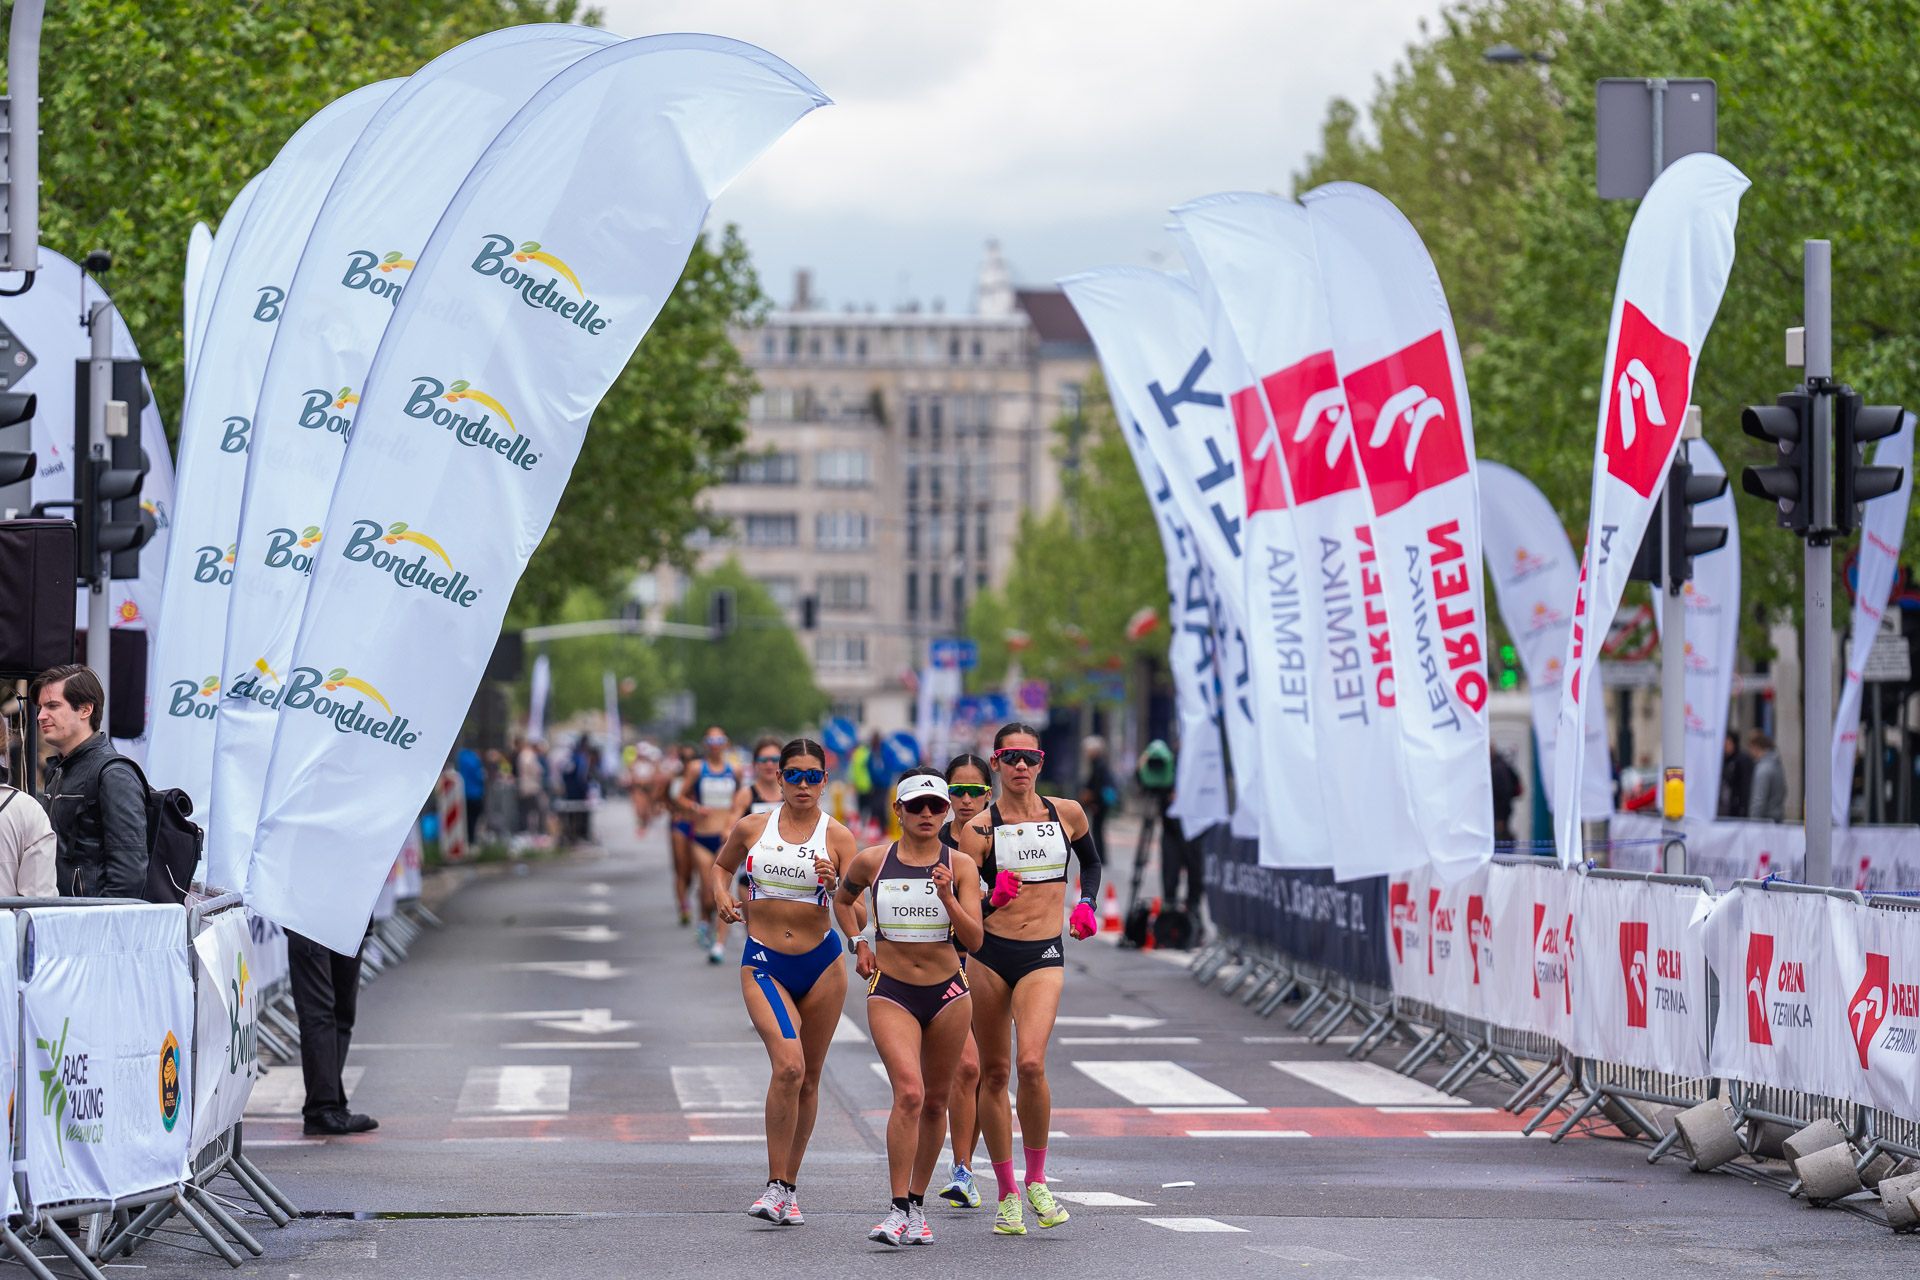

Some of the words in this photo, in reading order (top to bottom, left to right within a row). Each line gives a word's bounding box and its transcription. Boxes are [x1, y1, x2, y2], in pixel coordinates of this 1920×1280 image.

[471, 233, 608, 336] Bonduelle
[403, 376, 539, 471] Bonduelle
[342, 519, 477, 607] Bonduelle
[284, 666, 417, 749] Bonduelle
[1036, 823, 1055, 838] 53
[797, 846, 816, 860] 51
[1018, 848, 1047, 860] LYRA
[763, 863, 807, 880] GARCÍA
[925, 881, 935, 895] 5
[891, 906, 939, 918] TORRES
[1880, 1026, 1917, 1054] TERMIK
[62, 1053, 88, 1085] RACE
